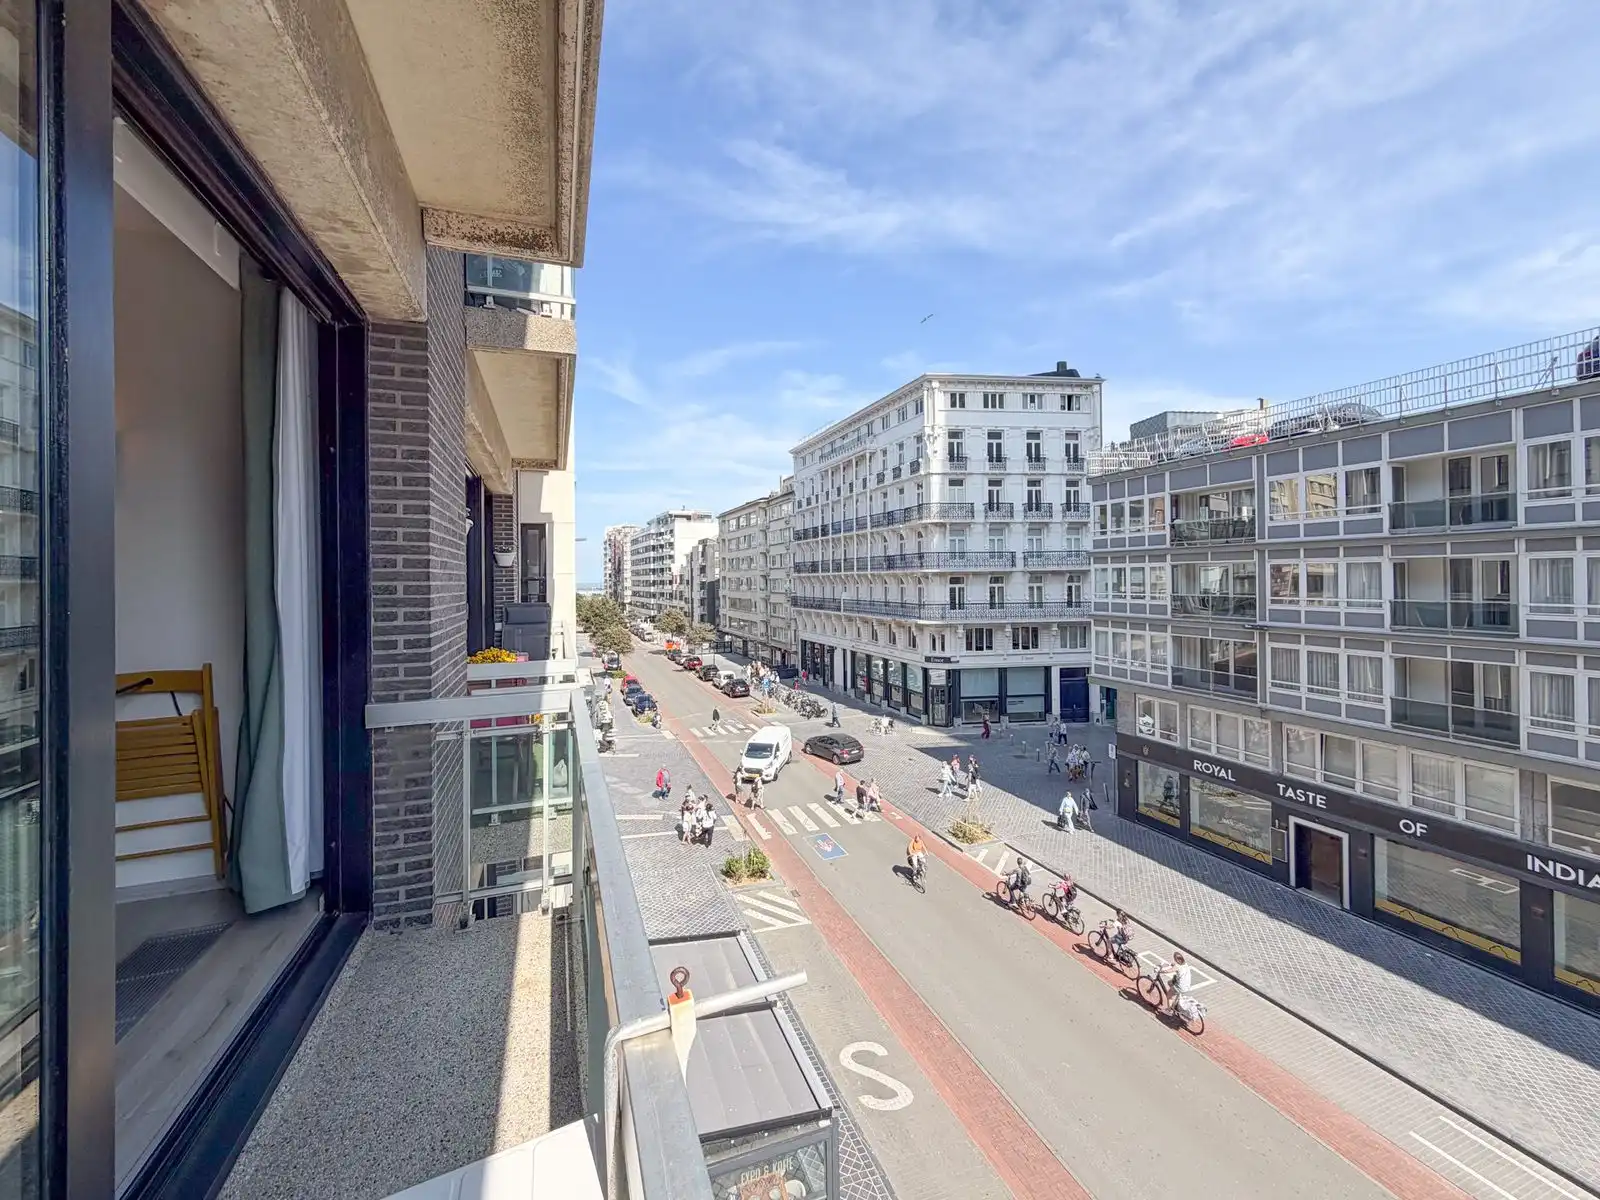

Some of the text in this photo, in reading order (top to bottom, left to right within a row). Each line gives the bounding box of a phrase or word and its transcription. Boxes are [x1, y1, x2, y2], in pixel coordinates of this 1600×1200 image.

[1194, 760, 1236, 781] ROYAL
[1277, 783, 1326, 808] TASTE
[1399, 819, 1427, 836] OF
[839, 1041, 914, 1111] S
[741, 1168, 761, 1187] EXPO
